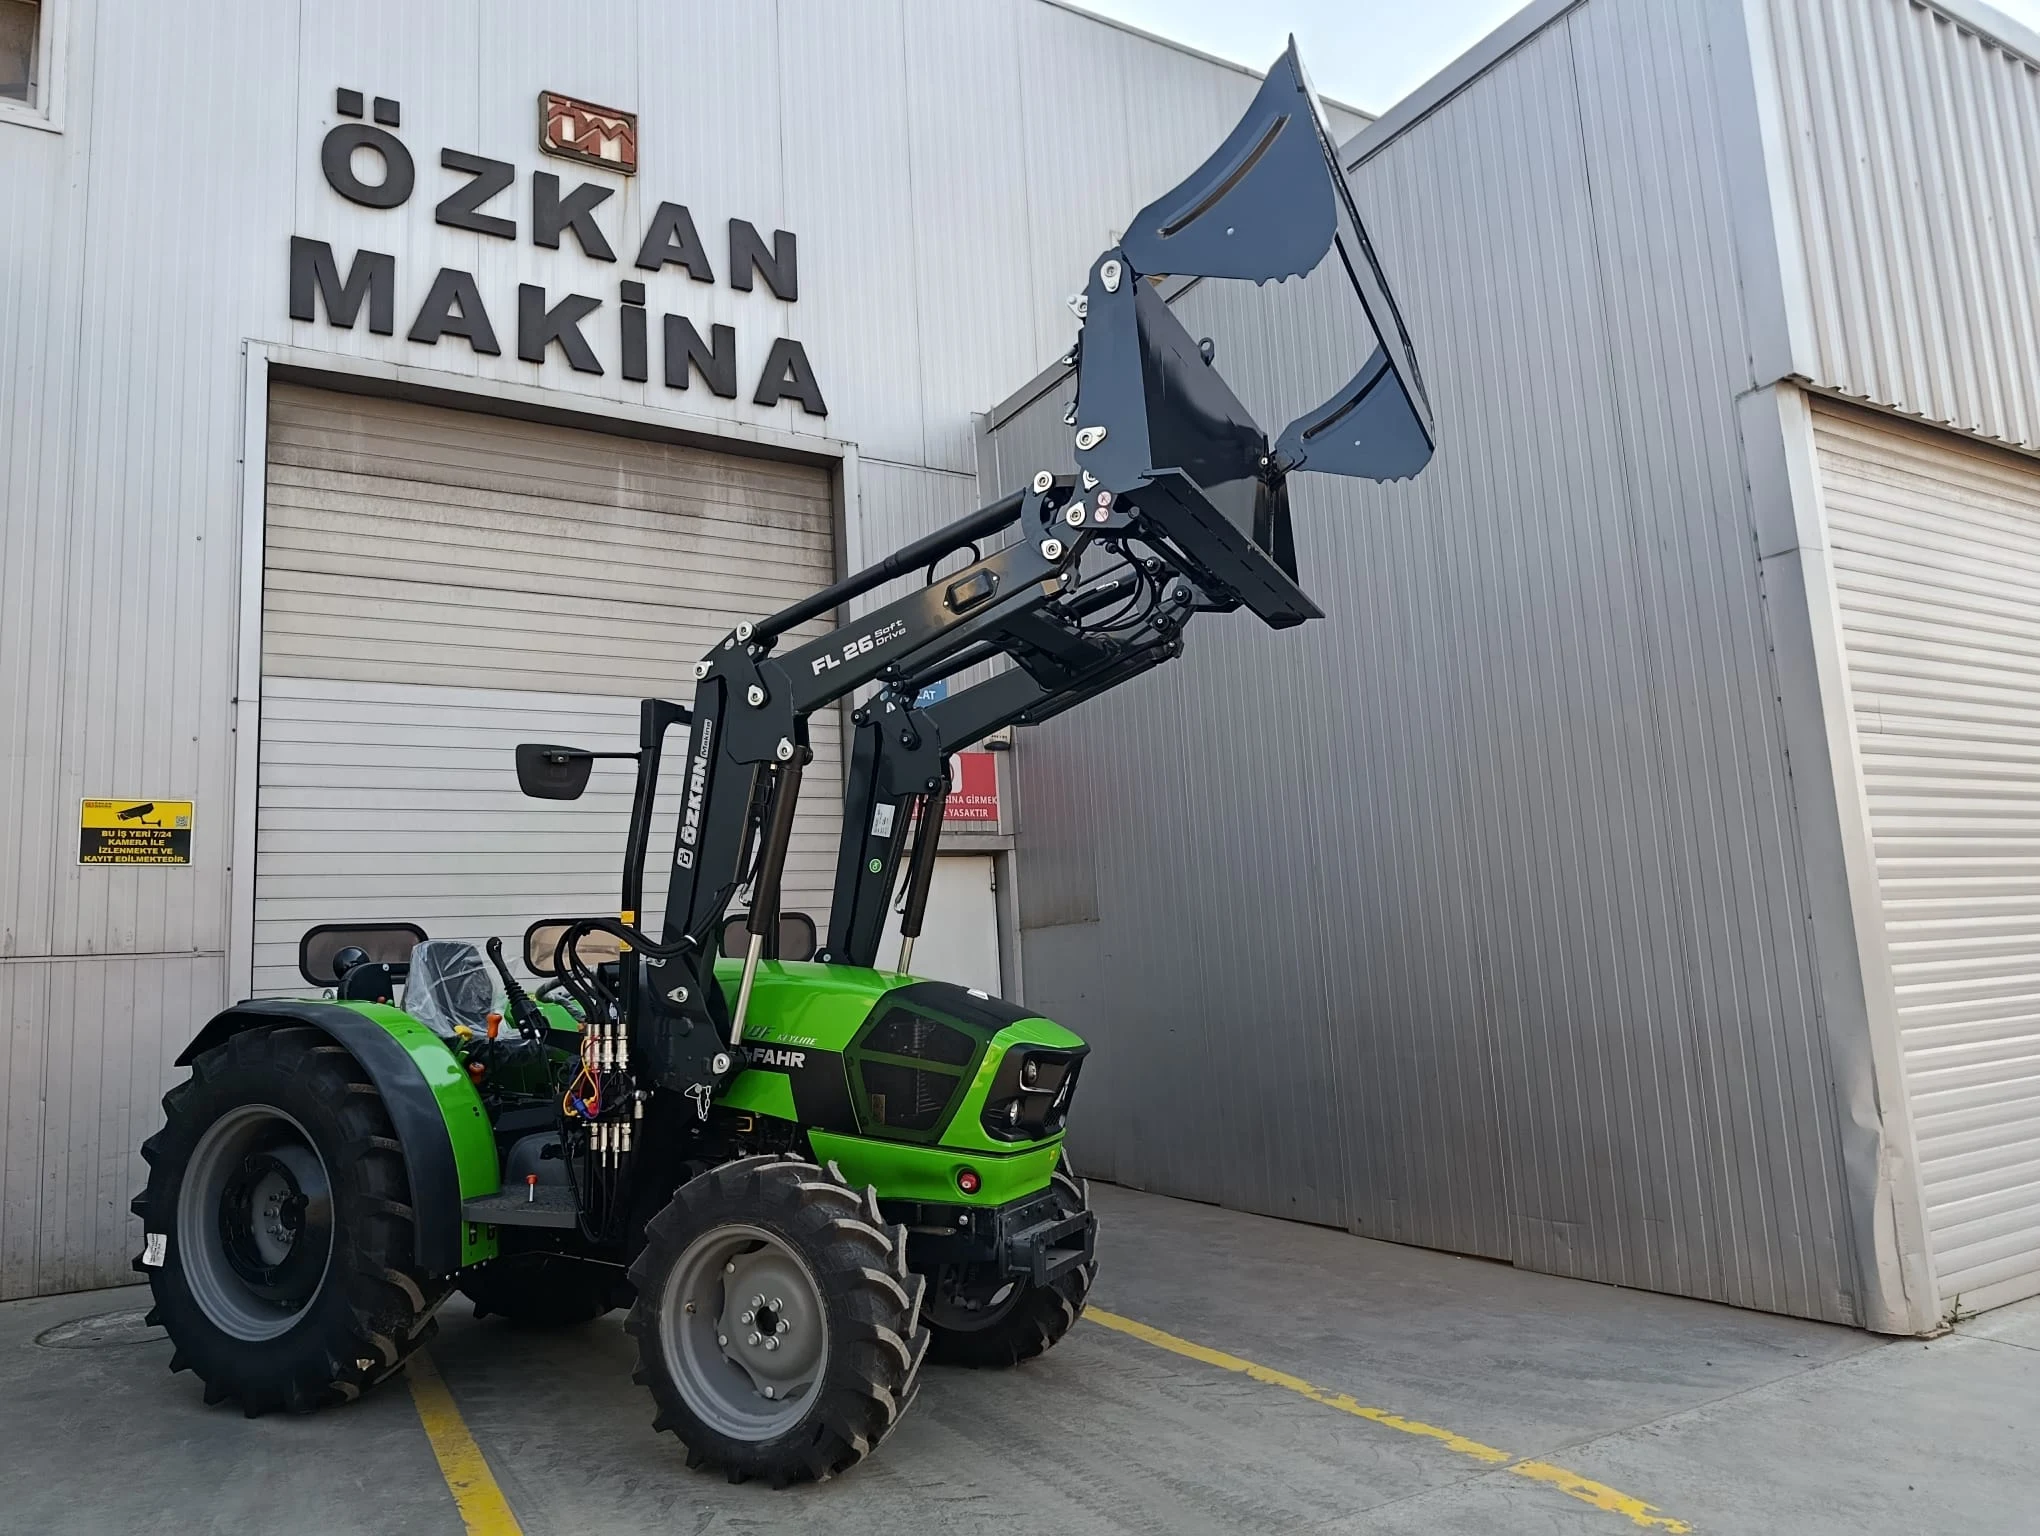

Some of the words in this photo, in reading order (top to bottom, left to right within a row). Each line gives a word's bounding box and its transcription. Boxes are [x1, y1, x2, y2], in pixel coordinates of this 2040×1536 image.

[321, 87, 798, 302] ÖZKAN
[289, 235, 828, 416] MAKİNA
[874, 619, 904, 638] Soft
[876, 627, 907, 647] Drive
[811, 654, 840, 676] FL
[843, 634, 874, 661] 26
[681, 755, 707, 845] ÖZKAN
[701, 720, 712, 756] Makina
[966, 794, 997, 804] GİRMEK
[949, 808, 988, 817] YASAKTIR
[118, 829, 127, 838] İŞ
[129, 829, 151, 837] YERİ
[108, 838, 148, 846] KAMERA
[150, 838, 165, 846] İLE
[98, 846, 159, 854] İZLENMEKTE
[115, 854, 186, 863] EDİLMEKTEDİR.
[776, 1033, 818, 1046] KEYLINE
